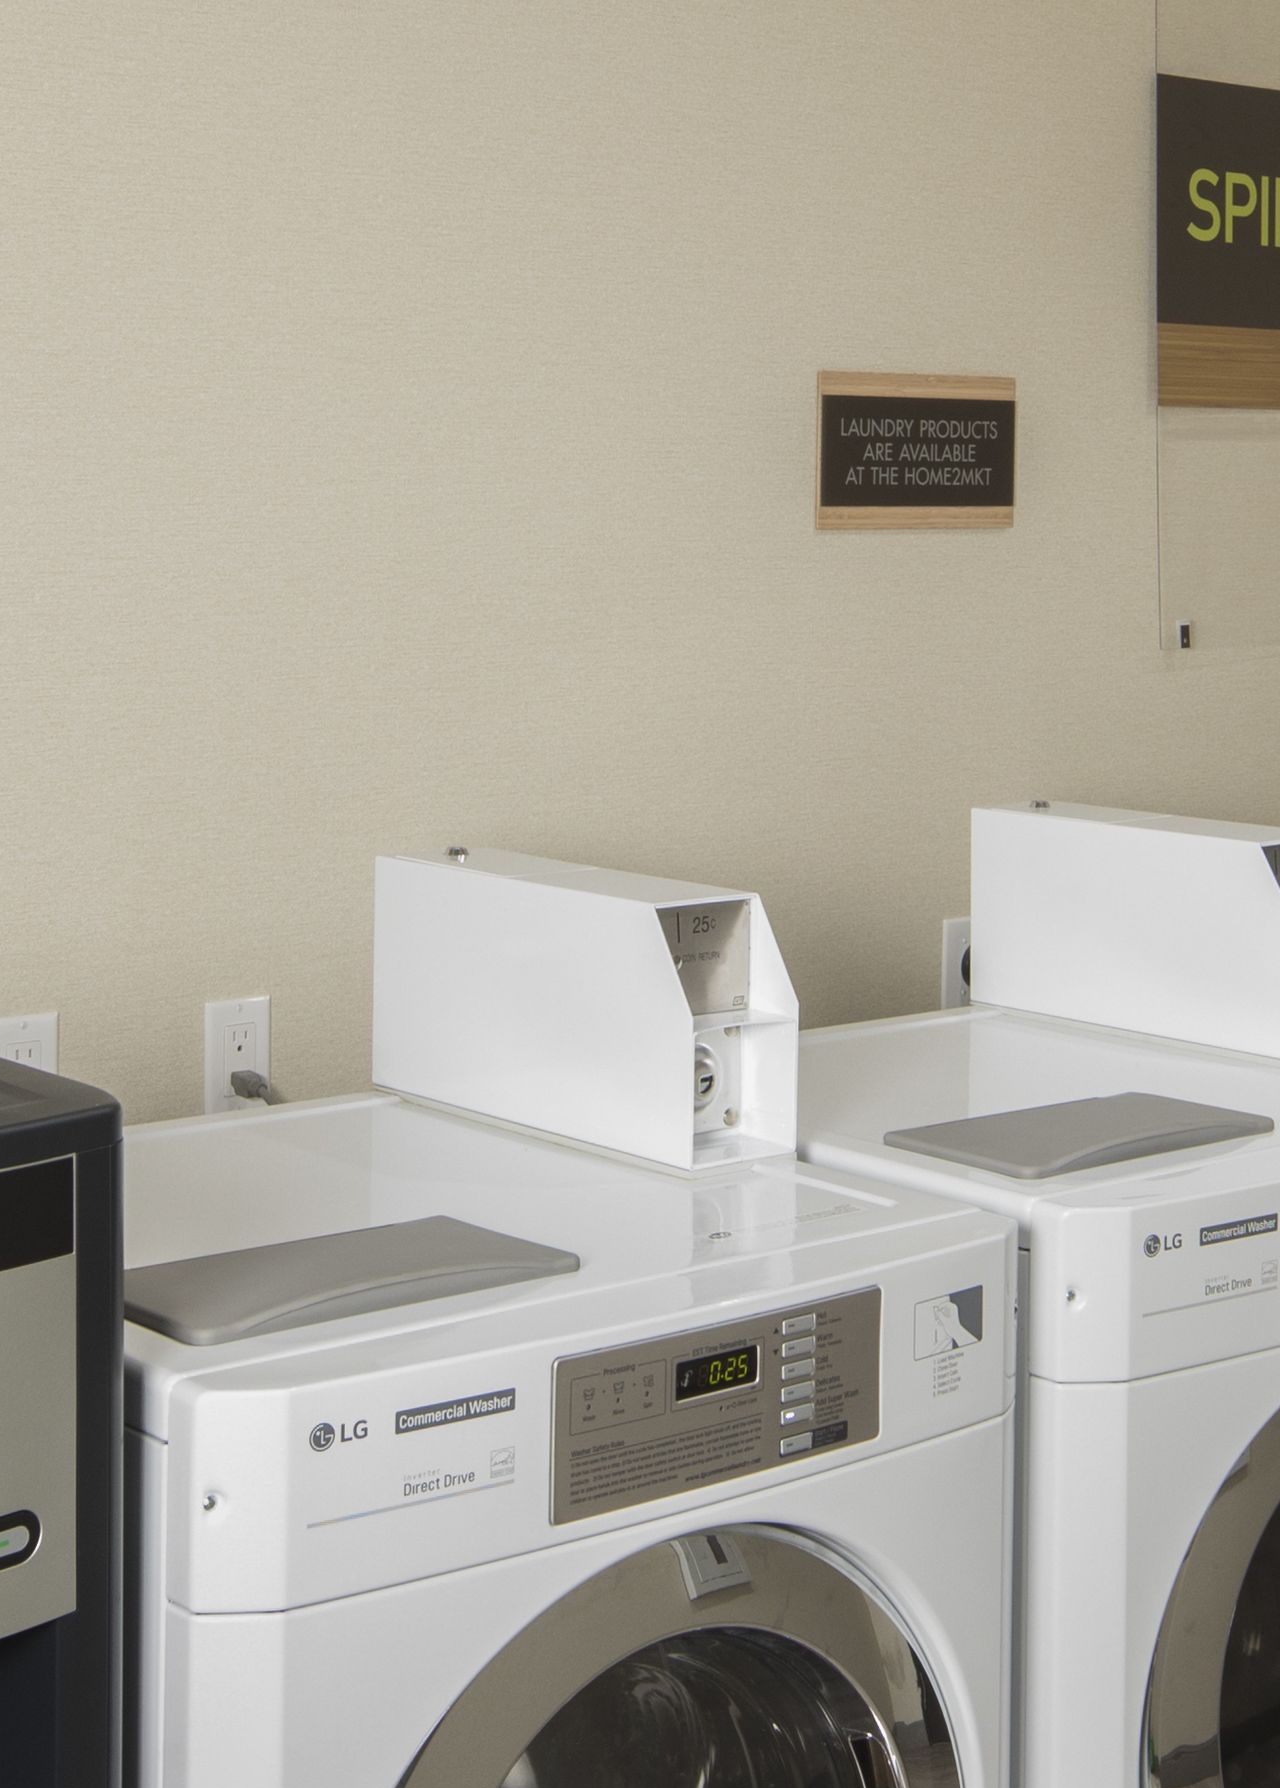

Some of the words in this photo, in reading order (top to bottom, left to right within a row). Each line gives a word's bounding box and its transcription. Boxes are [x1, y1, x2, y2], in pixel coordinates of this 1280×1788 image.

[841, 417, 914, 437] LAUNDRY
[920, 420, 998, 439] PRODUCTS
[863, 443, 893, 461] ARE
[899, 444, 976, 462] AVAILABLE
[845, 467, 865, 485] AT
[871, 467, 899, 485] THE
[905, 468, 992, 486] HOME2MKT
[1202, 1223, 1247, 1242] Commercial
[1247, 1219, 1276, 1233] Washer
[1164, 1233, 1183, 1251] LG
[1205, 1282, 1230, 1296] Direct
[1231, 1277, 1252, 1289] Drive
[399, 1403, 467, 1430] Commercial
[469, 1394, 513, 1415] Washer
[340, 1419, 368, 1443] LG
[403, 1478, 440, 1497] Direct
[444, 1471, 475, 1488] Drive
